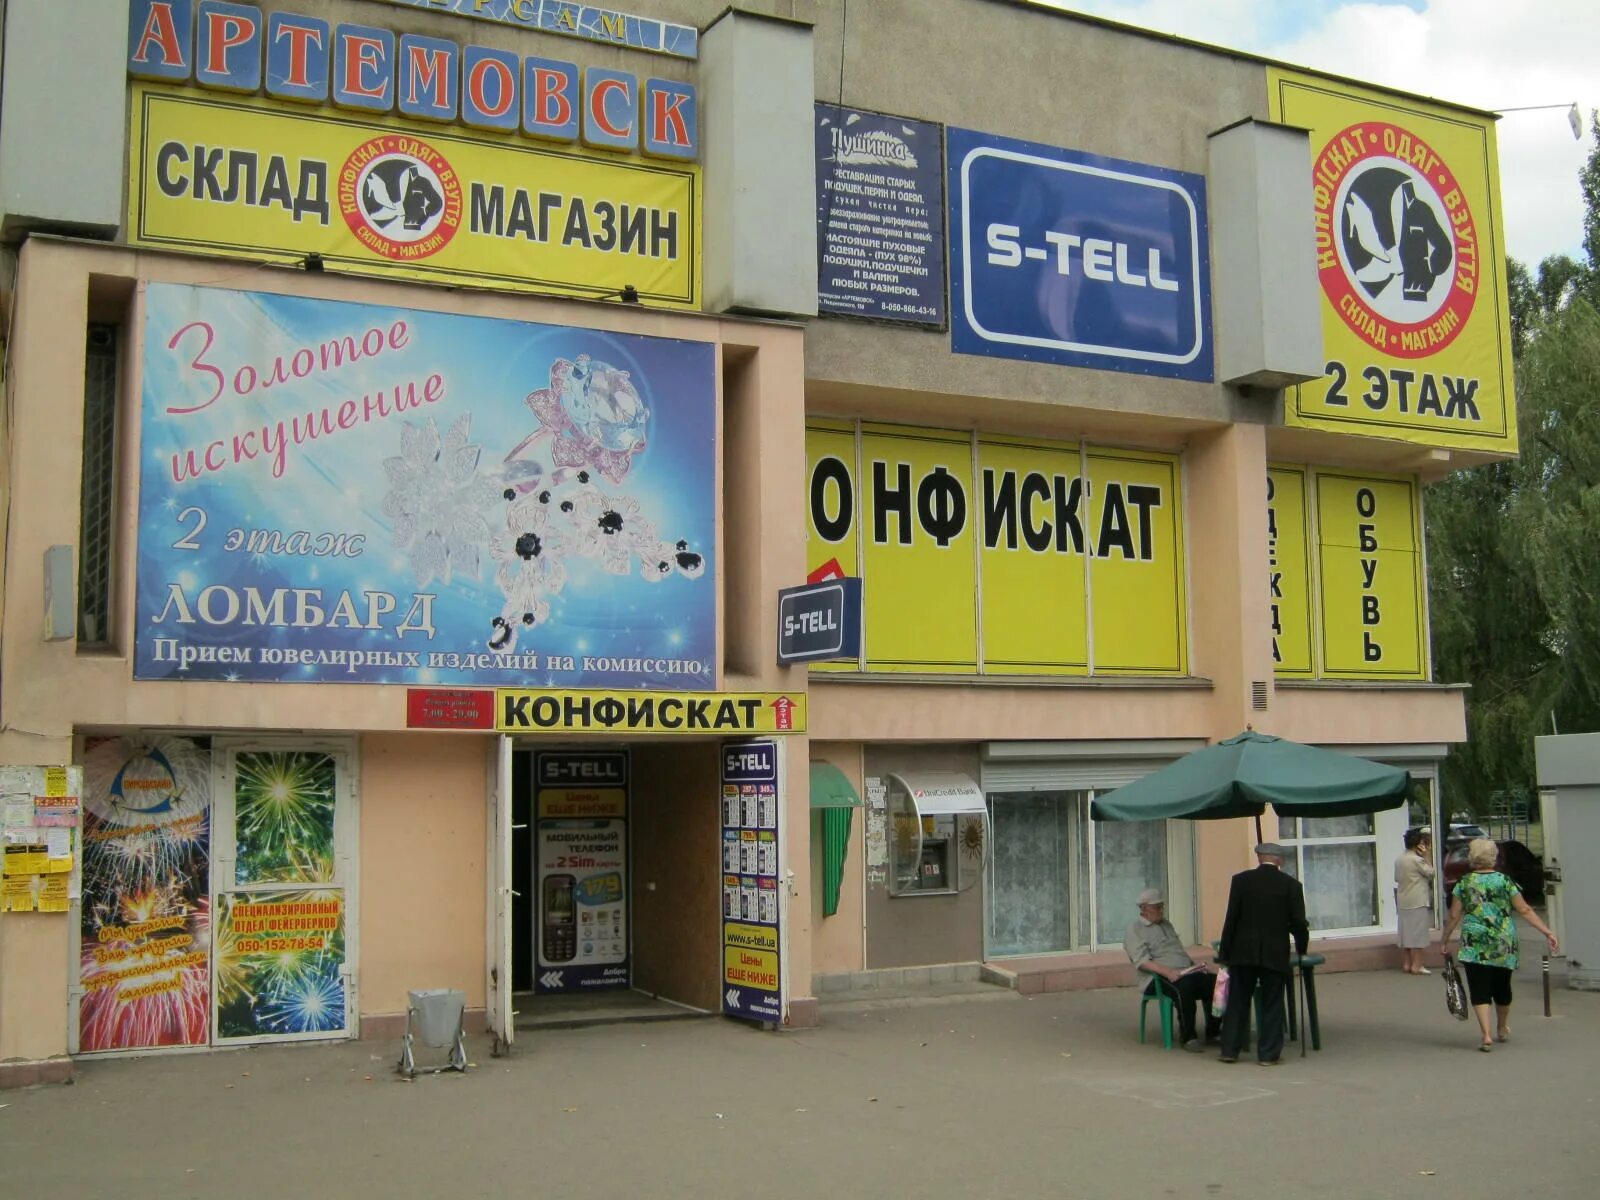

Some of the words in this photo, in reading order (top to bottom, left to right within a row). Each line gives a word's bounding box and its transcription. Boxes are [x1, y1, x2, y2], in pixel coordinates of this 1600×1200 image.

[131, 2, 692, 149] АРТЕМОВСК
[830, 127, 907, 161] Пушинка
[339, 139, 386, 214] КОНФІСКАТ
[397, 138, 439, 164] ОДЯГ
[437, 169, 459, 227] ВЗУТТЯ
[887, 176, 916, 190] СТАРЫХ
[155, 140, 331, 227] СКЛАД
[469, 181, 679, 261] МАГАЗИН
[1383, 128, 1441, 177] ОДЯГ
[1442, 188, 1477, 296] ВЗУТТЯ
[355, 225, 390, 254] СКЛАД
[399, 233, 445, 257] МАГАЗИН
[829, 244, 866, 257] ОДЕЯЛА
[874, 250, 896, 261] (ПУХ
[882, 241, 926, 254] ПУХОВЫЕ
[986, 222, 1179, 292] S-TELL
[831, 278, 869, 290] ЛЮБЫХ
[870, 282, 920, 297] РАЗМЕРОВ.
[853, 269, 860, 278] И
[862, 270, 899, 283] ВАЛИКИ
[1338, 293, 1388, 349] СКЛАД
[1401, 306, 1460, 352] МАГАЗИН
[165, 320, 411, 416] Золотое
[1324, 360, 1349, 407] 2
[1361, 365, 1482, 422] ЭТАЖ
[170, 372, 446, 484] искушение
[810, 456, 1162, 562] ОНФИСКАТ
[170, 506, 208, 552] 2
[223, 521, 367, 560] этаж
[1355, 487, 1383, 663] ОБУВЬ
[151, 584, 438, 640] ЛОМБАРД
[784, 607, 838, 638] S-TELL
[151, 637, 253, 670] Прием
[259, 644, 420, 674] ювелирных
[427, 651, 539, 674] изделий
[546, 654, 576, 672] на
[581, 656, 703, 677] комиссию
[504, 695, 762, 729] КОНФИСКАТ
[778, 698, 788, 708] 2
[546, 762, 619, 777] S-TELL
[727, 752, 771, 772] S-TELL
[546, 831, 619, 842] МОБИЛЬНЫЙ
[568, 844, 620, 854] ТЕЛЕФОН
[557, 857, 566, 869] 2
[568, 855, 596, 869] Sim
[234, 919, 265, 933] ОТДЕЛ
[268, 917, 337, 931] ФЕЙЕРВЕРКОВ
[727, 933, 776, 948] www.s-tell.ua
[237, 937, 324, 953] 050-152-78-54
[740, 951, 763, 968] Цены
[746, 970, 777, 987] НИЖЕ!
